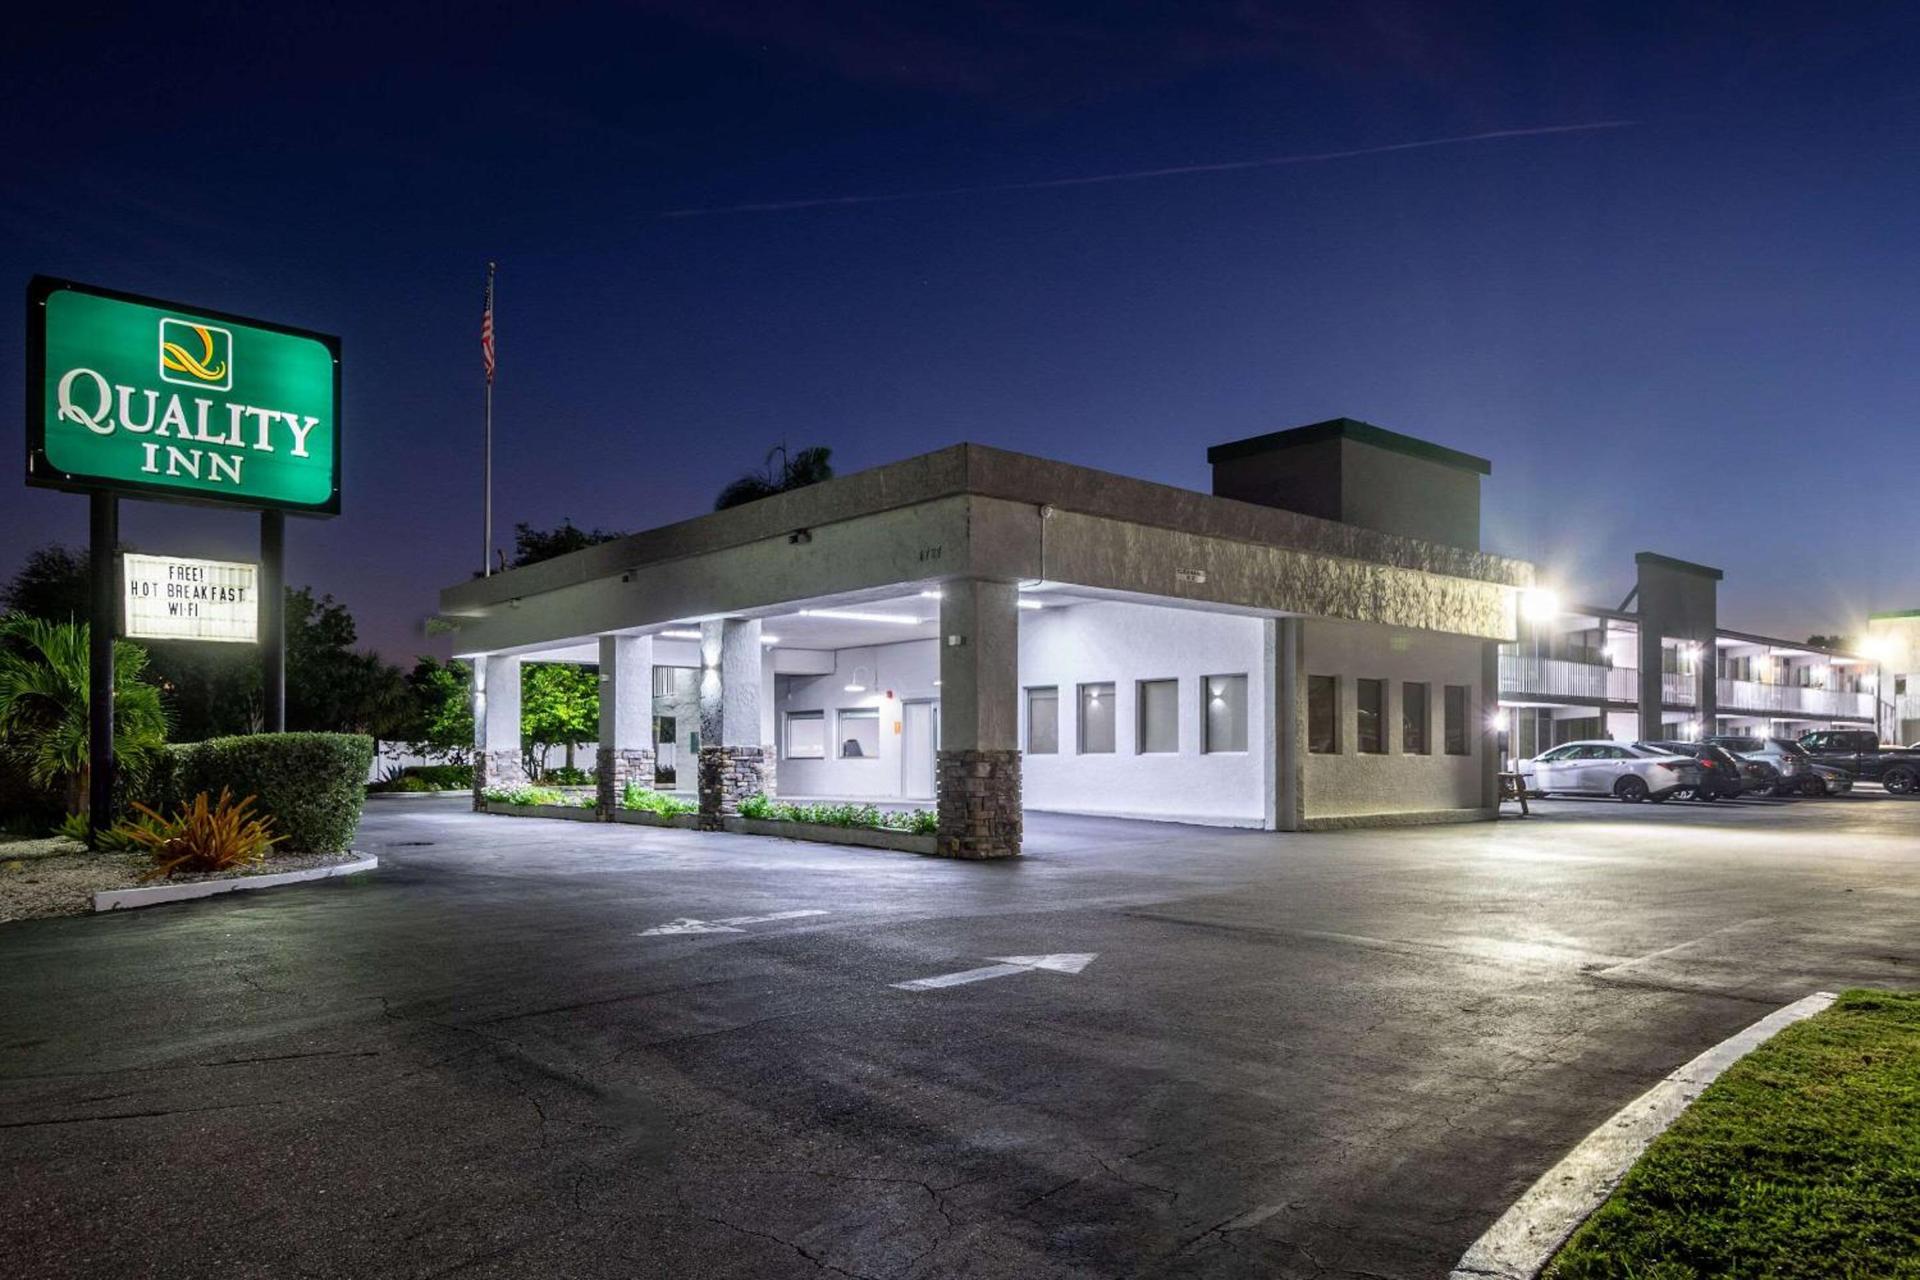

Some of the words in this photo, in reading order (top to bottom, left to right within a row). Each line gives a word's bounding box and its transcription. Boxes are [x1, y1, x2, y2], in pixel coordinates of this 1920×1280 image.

[57, 368, 319, 458] QUALITY
[141, 442, 244, 485] INN
[168, 565, 203, 583] FREE!
[131, 581, 158, 597] HOT
[167, 583, 244, 602] BREAKFAST
